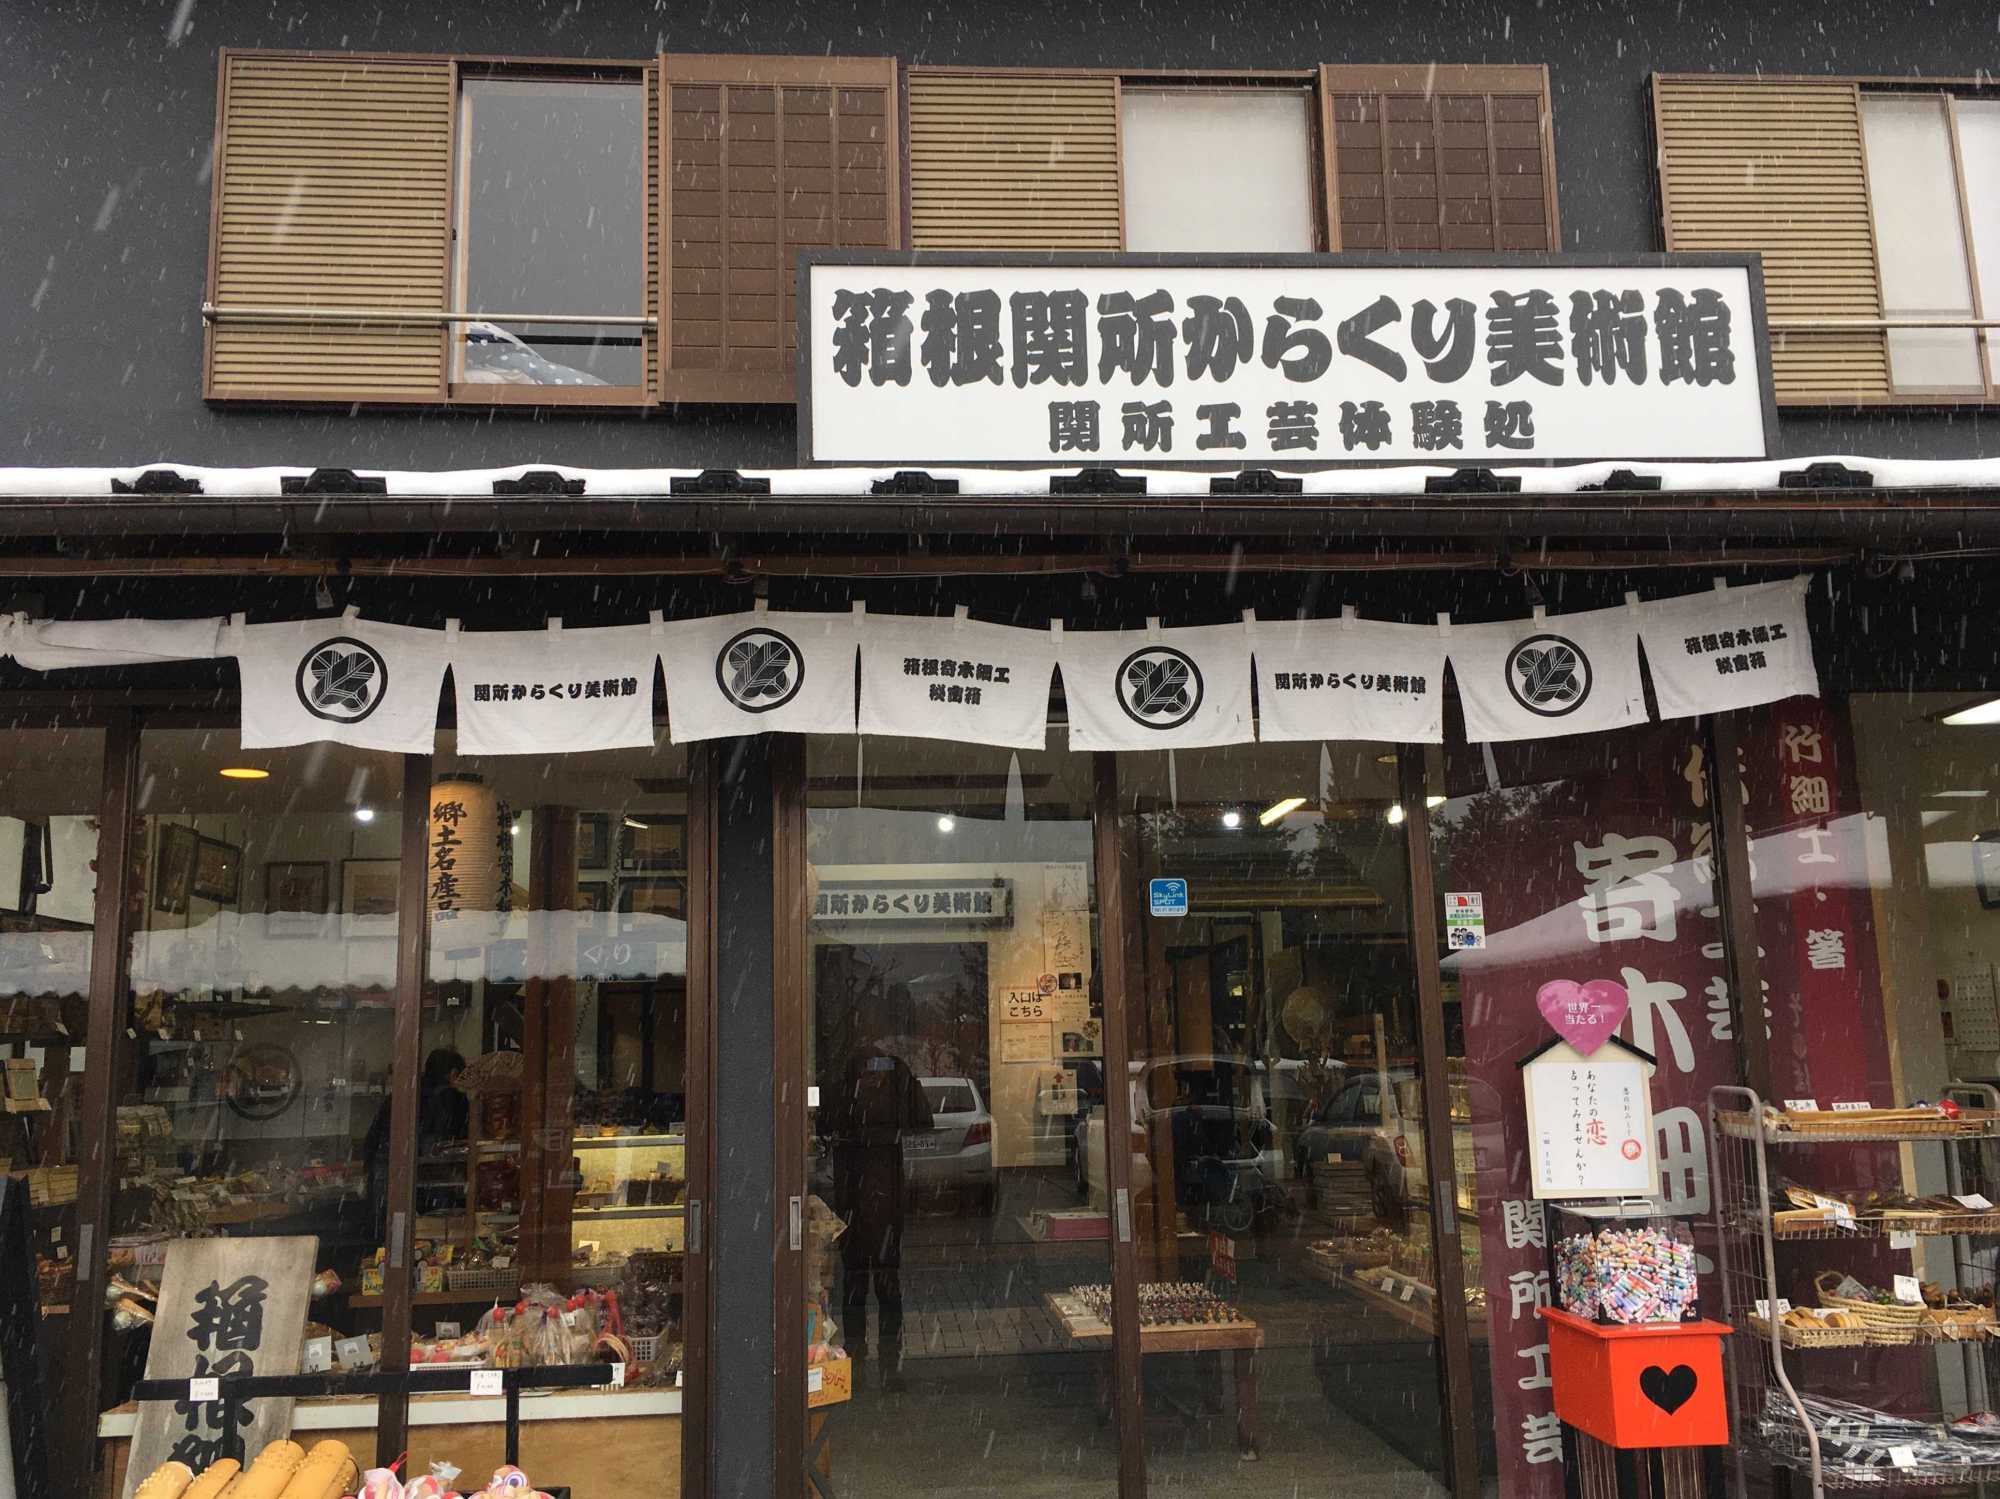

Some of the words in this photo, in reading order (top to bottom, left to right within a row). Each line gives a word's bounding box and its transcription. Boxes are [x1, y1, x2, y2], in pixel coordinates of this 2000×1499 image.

[832, 288, 1736, 388] 箱根関所からくり美術館
[1048, 400, 1535, 453] 関所工芸体験処
[474, 677, 638, 702] 関所からくり美術館
[1275, 673, 1426, 694] 関所からくり美術館
[1008, 1005, 1044, 1018] こちら
[1567, 1001, 1601, 1013] 世界一
[1586, 1069, 1608, 1146] あなたの恋
